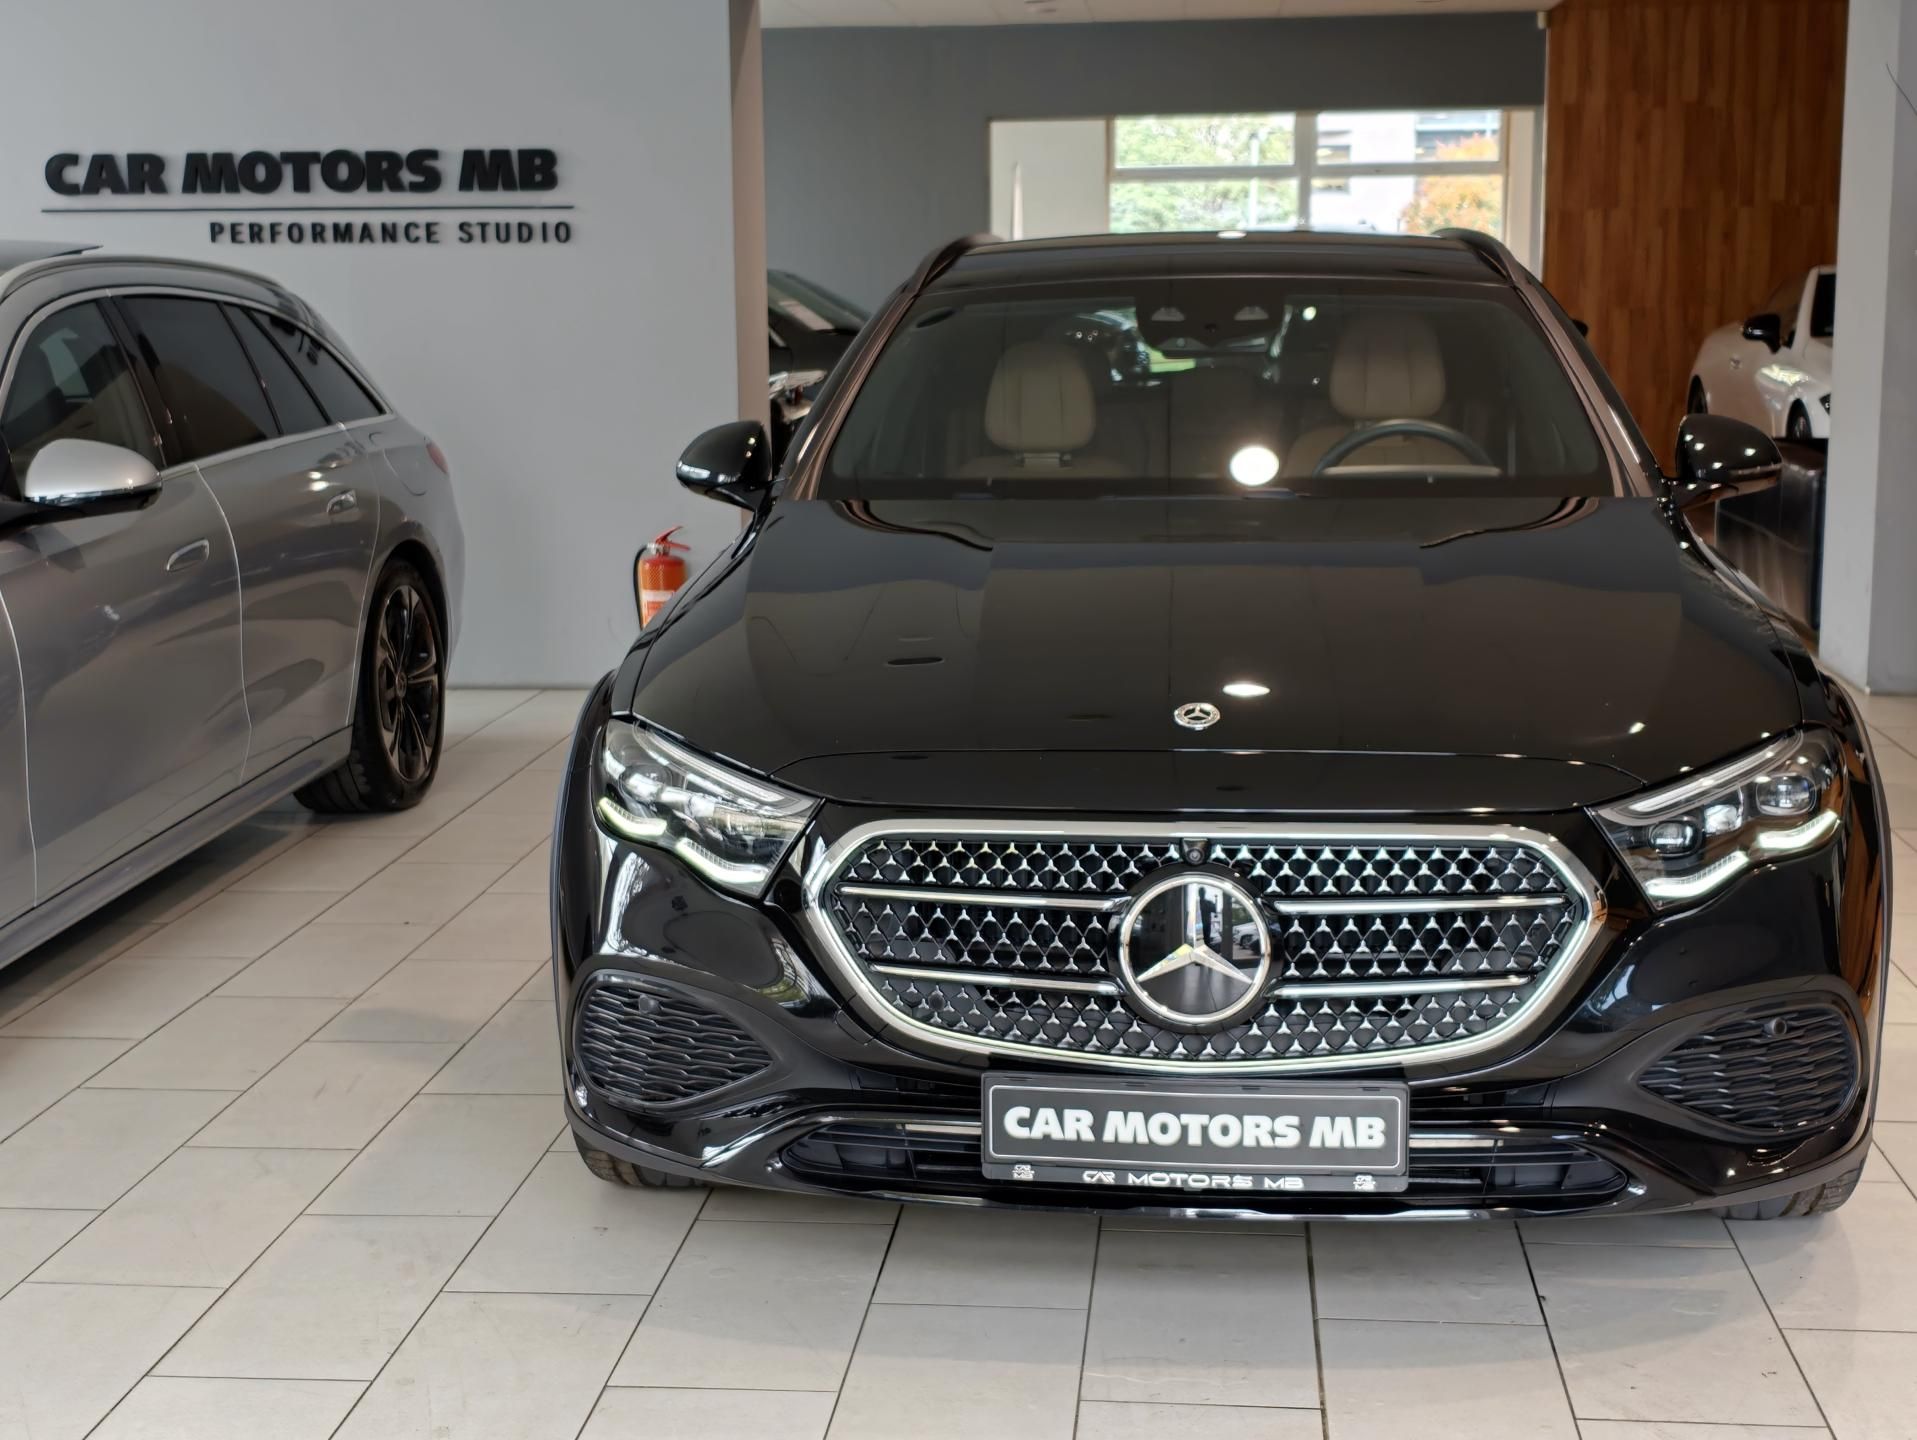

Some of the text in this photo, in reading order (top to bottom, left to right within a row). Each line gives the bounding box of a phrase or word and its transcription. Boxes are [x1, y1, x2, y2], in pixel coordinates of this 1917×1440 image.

[44, 148, 558, 196] CAR MOTORS MB
[209, 220, 572, 244] PERFORMANCE STUDIO
[1003, 1106, 1386, 1148] CAR MOTORS MB
[1082, 1170, 1305, 1190] CAR MOTORS MB
